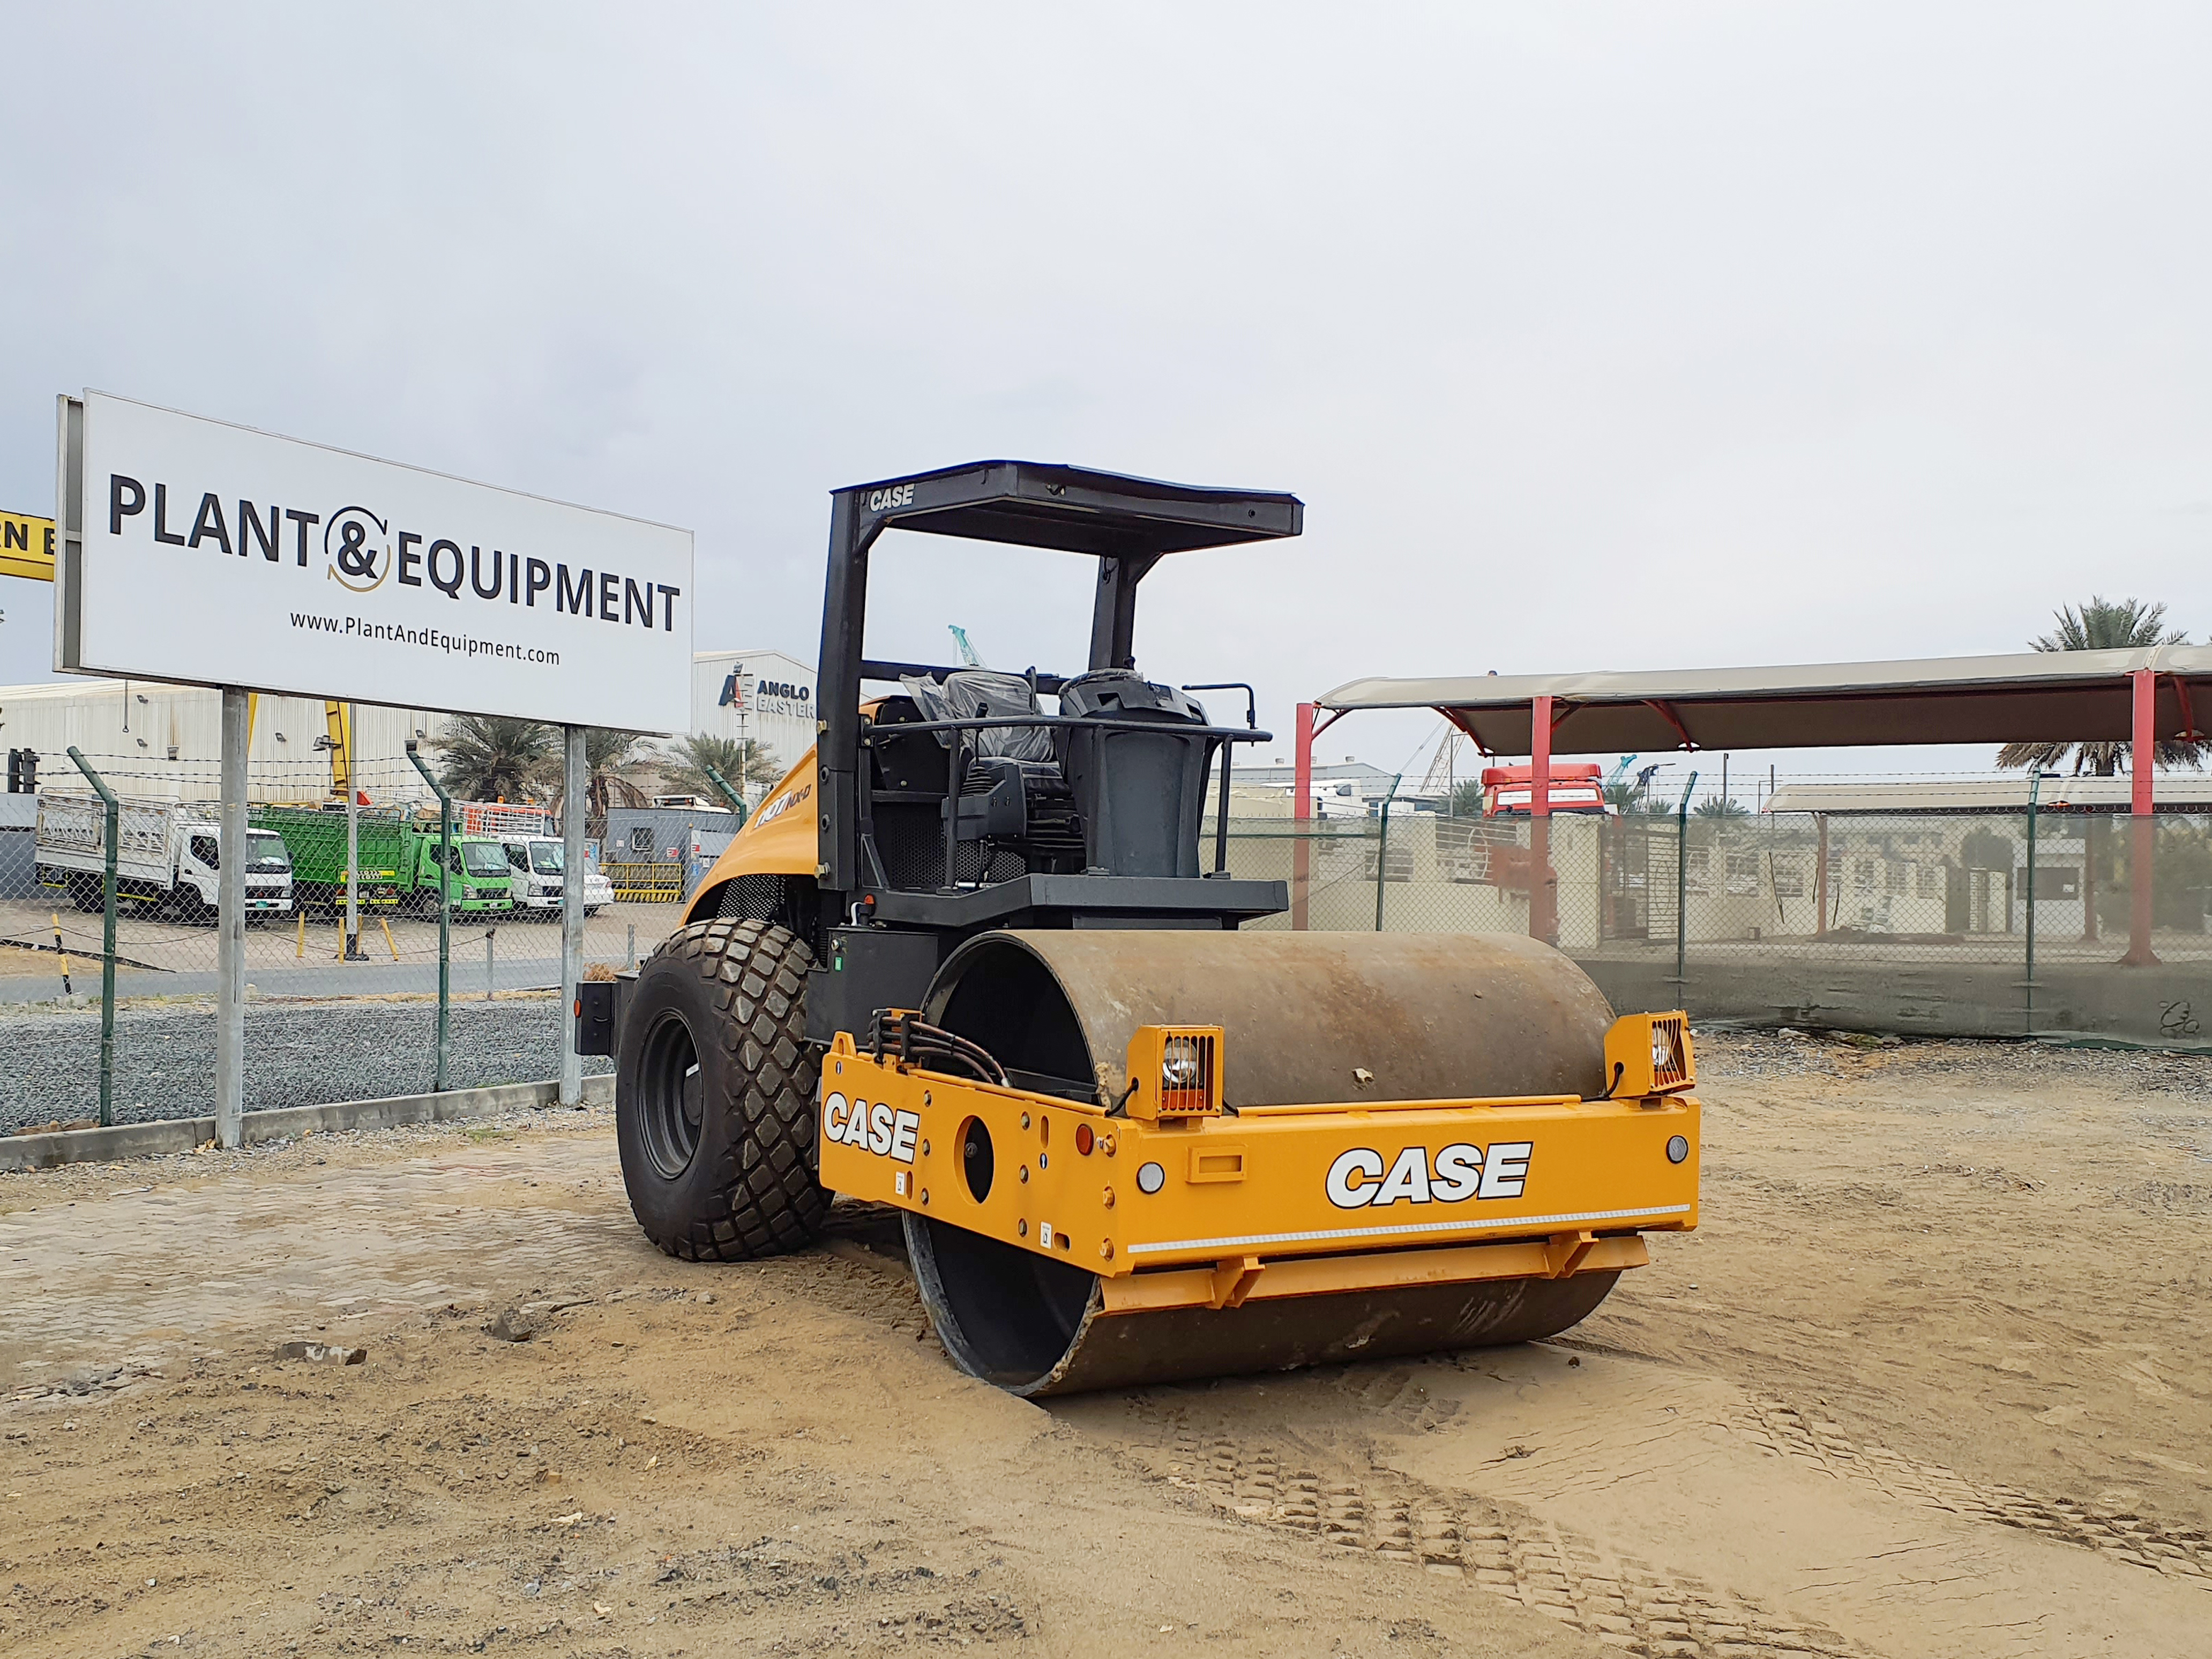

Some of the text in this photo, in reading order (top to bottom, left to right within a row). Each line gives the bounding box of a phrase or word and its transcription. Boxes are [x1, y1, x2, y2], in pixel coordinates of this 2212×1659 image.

[870, 483, 915, 512] CASE
[110, 474, 319, 567] PLANT
[398, 531, 680, 631] EQUIPMENT
[290, 612, 559, 665] www.PlantAndEquipment.com
[757, 680, 809, 701] ANGLO
[823, 1091, 920, 1164] CASE
[1325, 1141, 1534, 1209] CASE
